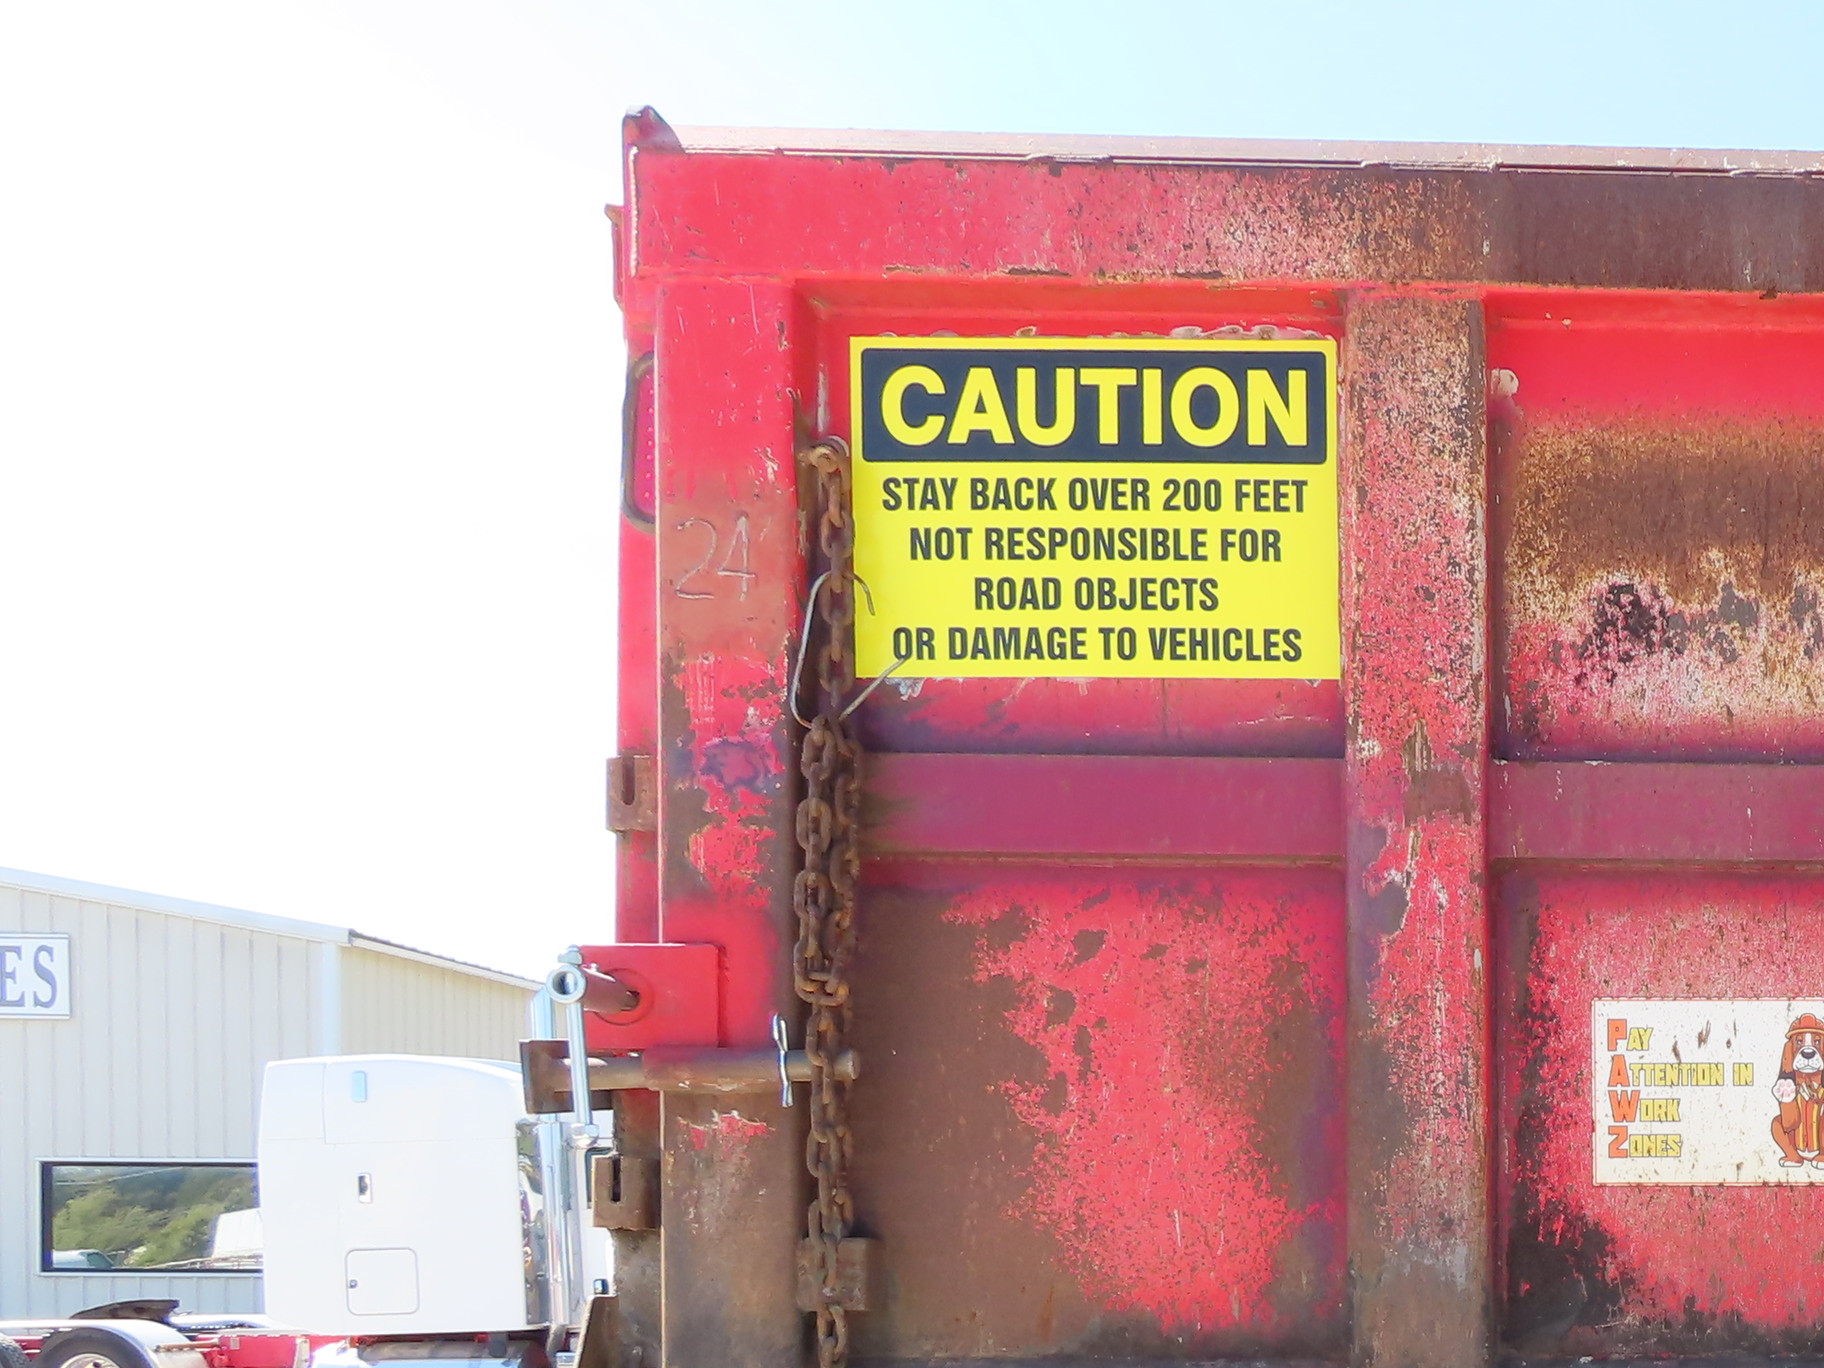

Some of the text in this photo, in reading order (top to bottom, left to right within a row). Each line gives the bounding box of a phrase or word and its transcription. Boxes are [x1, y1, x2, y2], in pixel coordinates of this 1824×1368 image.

[881, 365, 1308, 448] CAUTION
[882, 477, 1308, 513] STAY BACK OVER 200 FEET
[910, 527, 1281, 562] NOT RESPONSIBLE FOR
[974, 577, 1219, 612] ROAD OBJECTS
[893, 627, 1302, 662] OR DAMAGE TO VEHICLES
